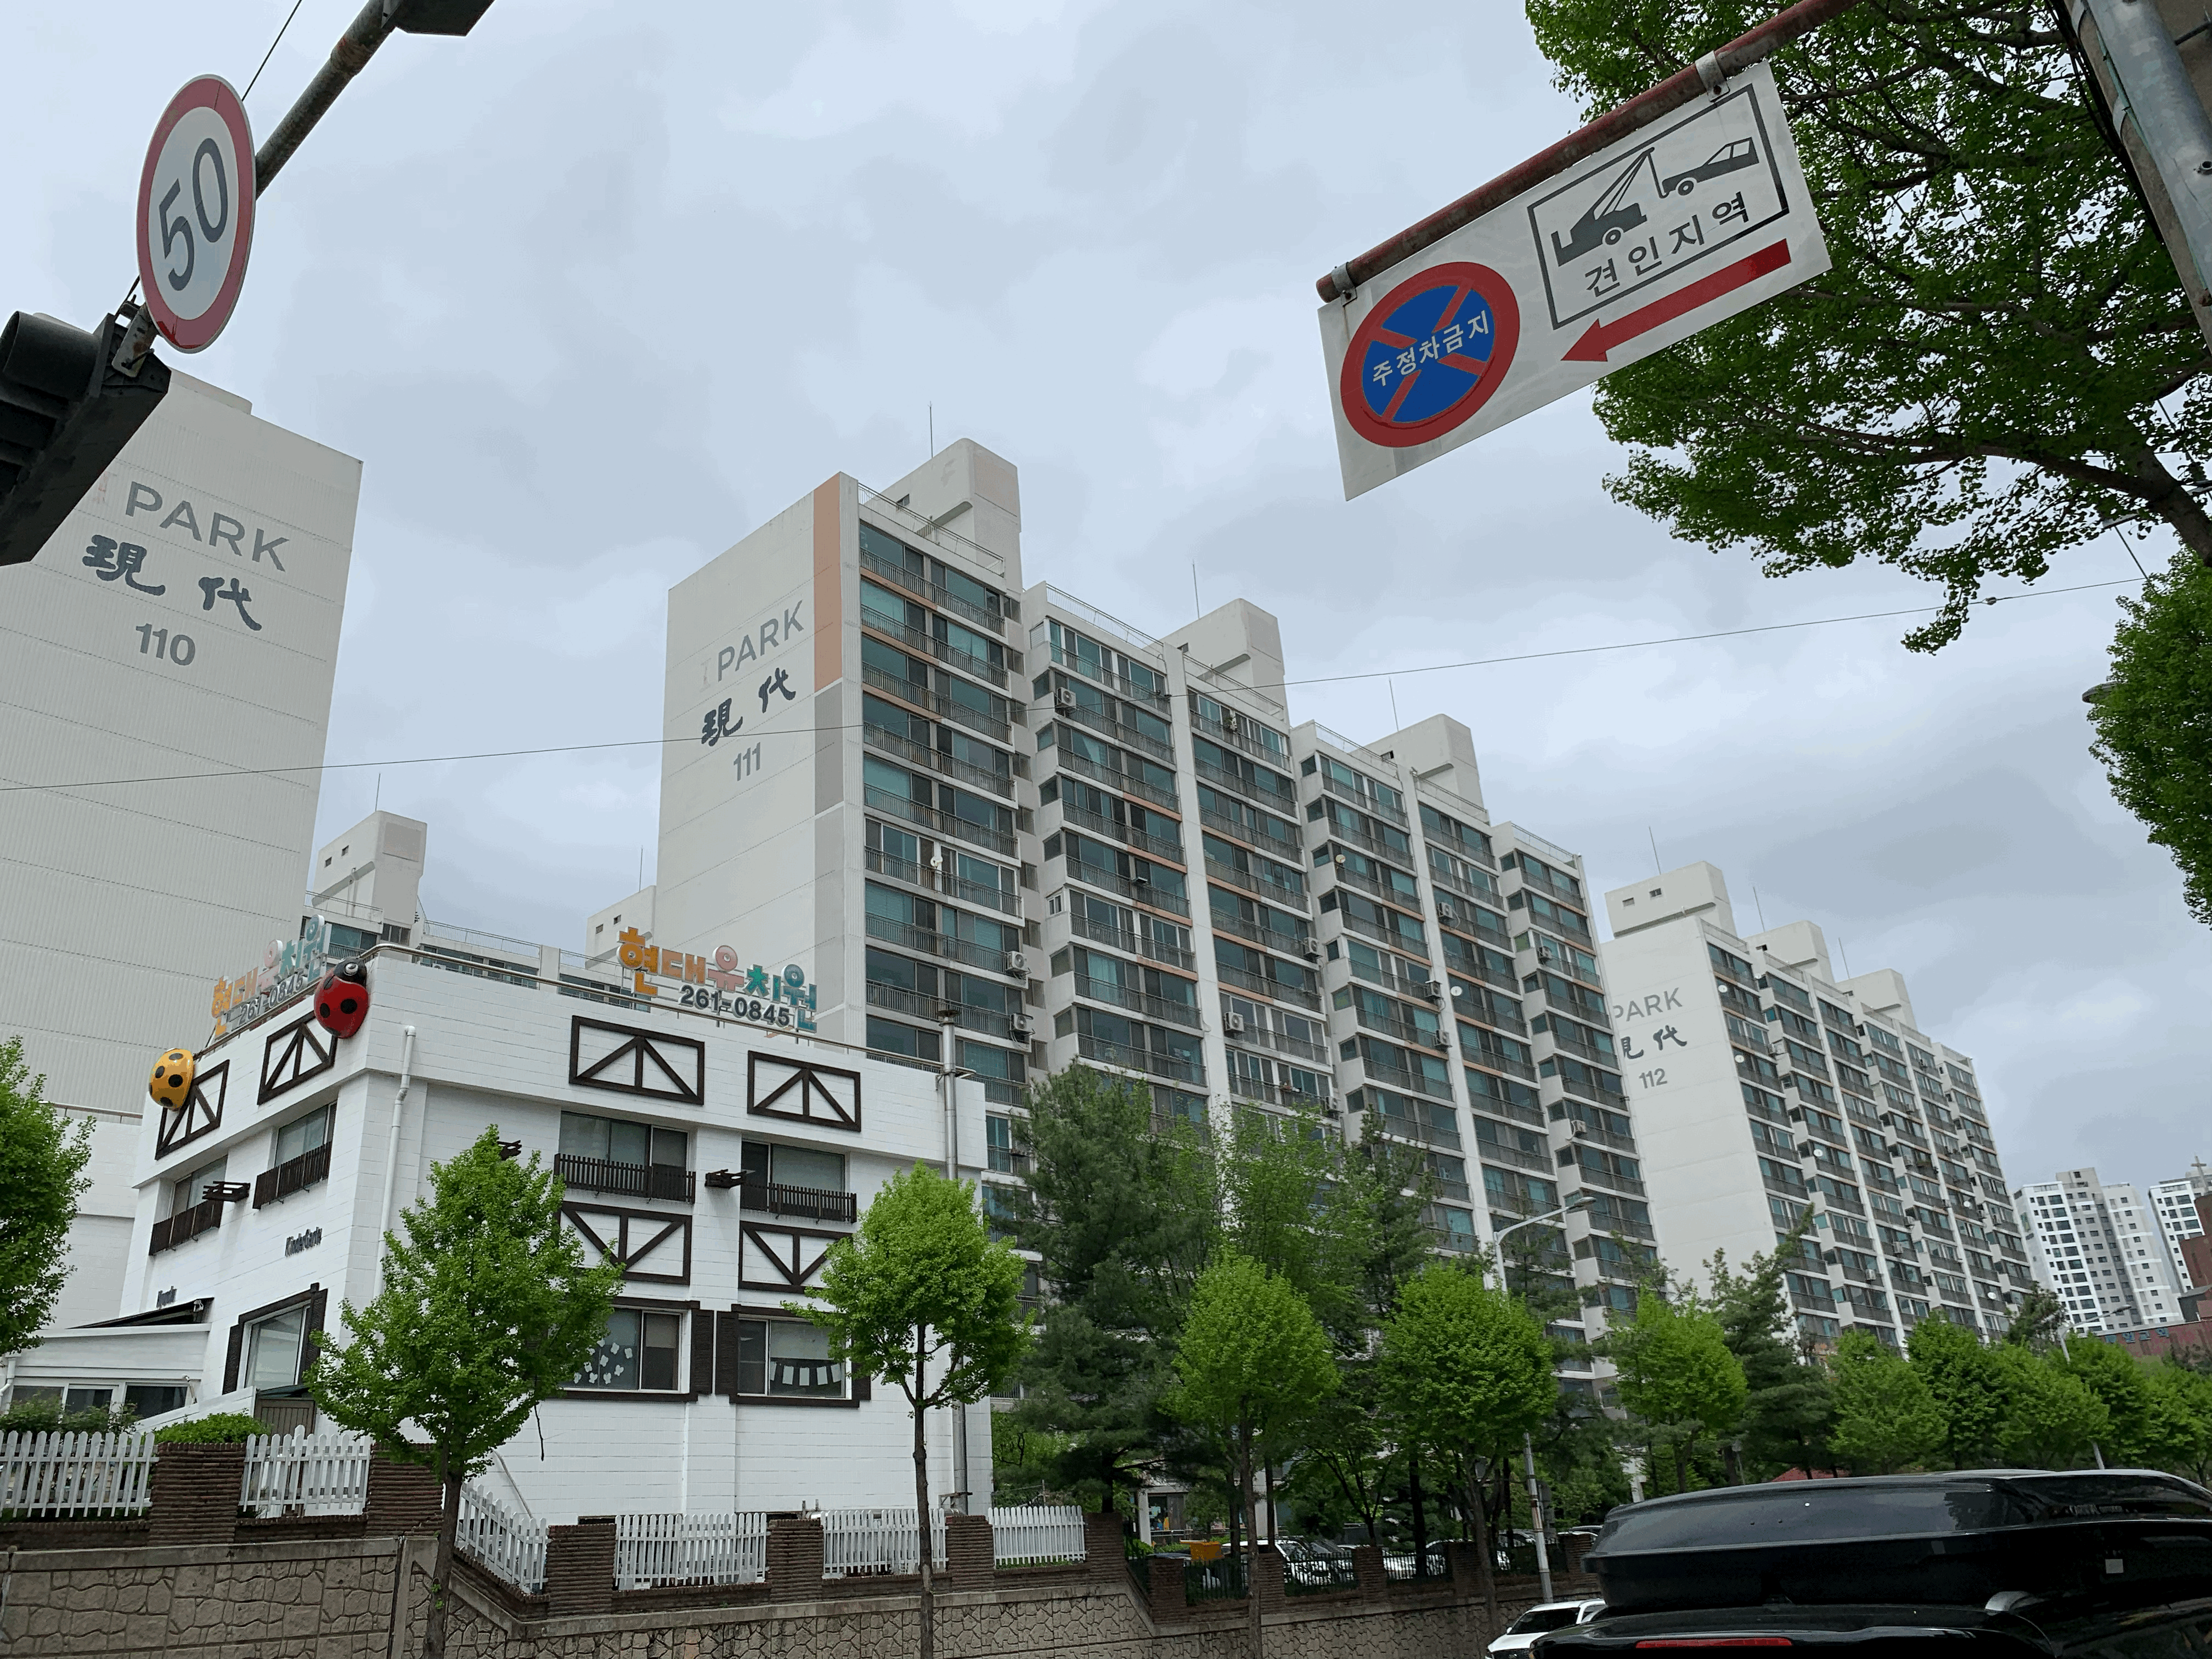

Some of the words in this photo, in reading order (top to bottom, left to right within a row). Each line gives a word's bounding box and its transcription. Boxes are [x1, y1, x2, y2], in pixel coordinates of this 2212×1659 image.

[159, 138, 228, 291] 50
[1585, 191, 1749, 297] 견인지역
[1373, 310, 1489, 386] 주정차금지
[125, 481, 291, 572] PARK
[82, 534, 262, 631] 現代
[136, 623, 196, 666] 110
[701, 668, 797, 747] 現代
[733, 742, 761, 781] 111
[678, 984, 791, 1028] 261-0845
[1639, 1068, 1668, 1089] 112
